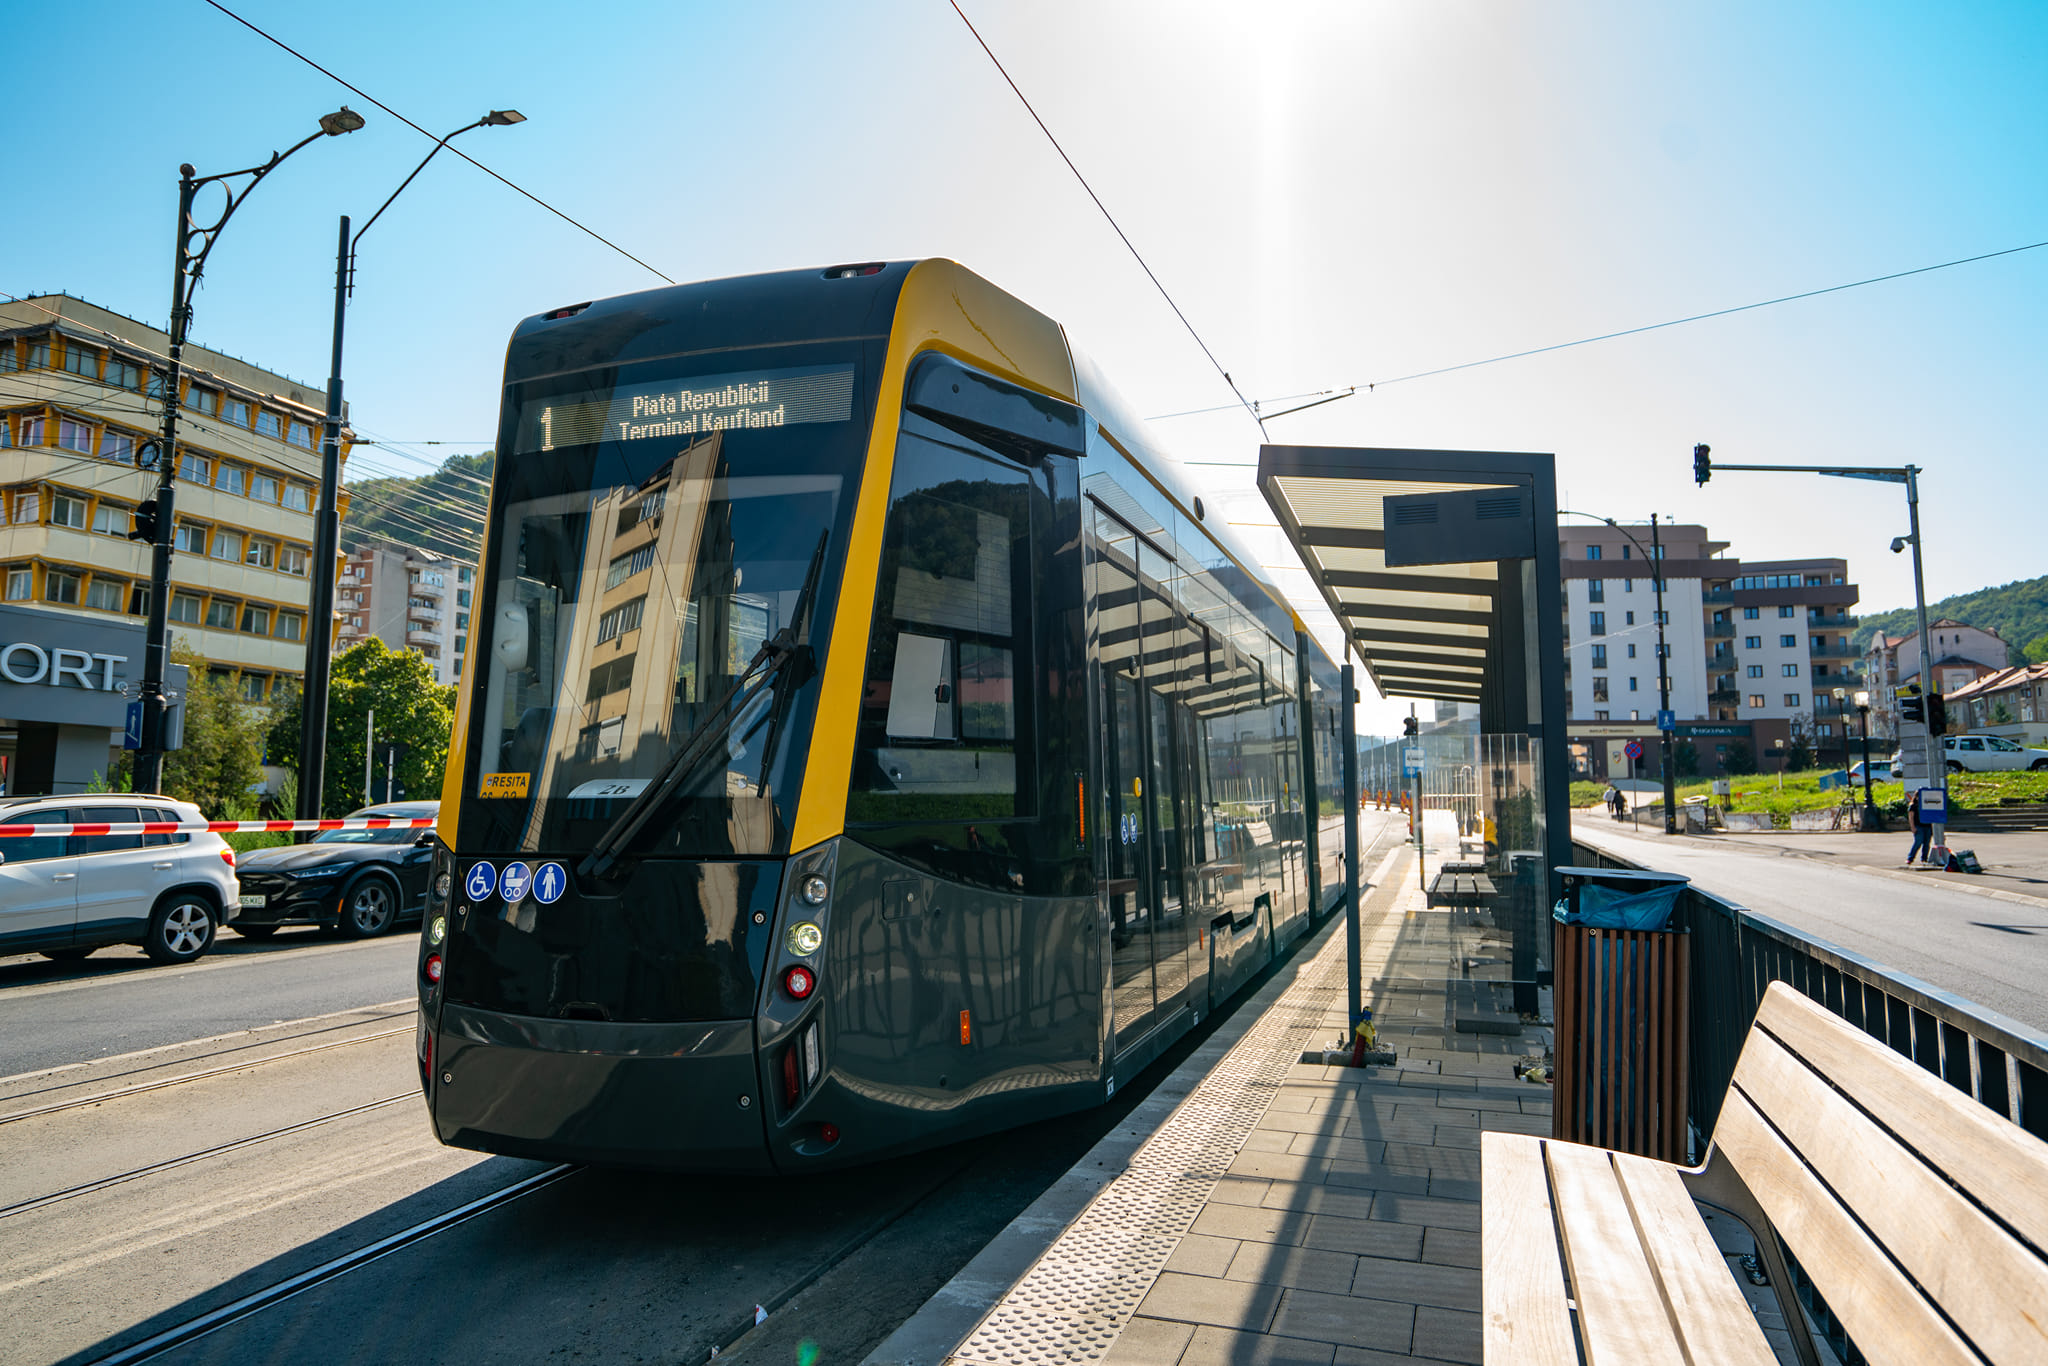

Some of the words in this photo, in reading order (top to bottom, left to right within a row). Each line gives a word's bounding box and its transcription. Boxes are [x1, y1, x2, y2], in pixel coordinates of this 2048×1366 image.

[633, 393, 676, 417] Piata
[681, 381, 769, 412] Republicii
[540, 407, 555, 452] 1
[619, 414, 697, 441] Terminal
[702, 404, 785, 431] Kaufland
[492, 776, 526, 788] RESITA
